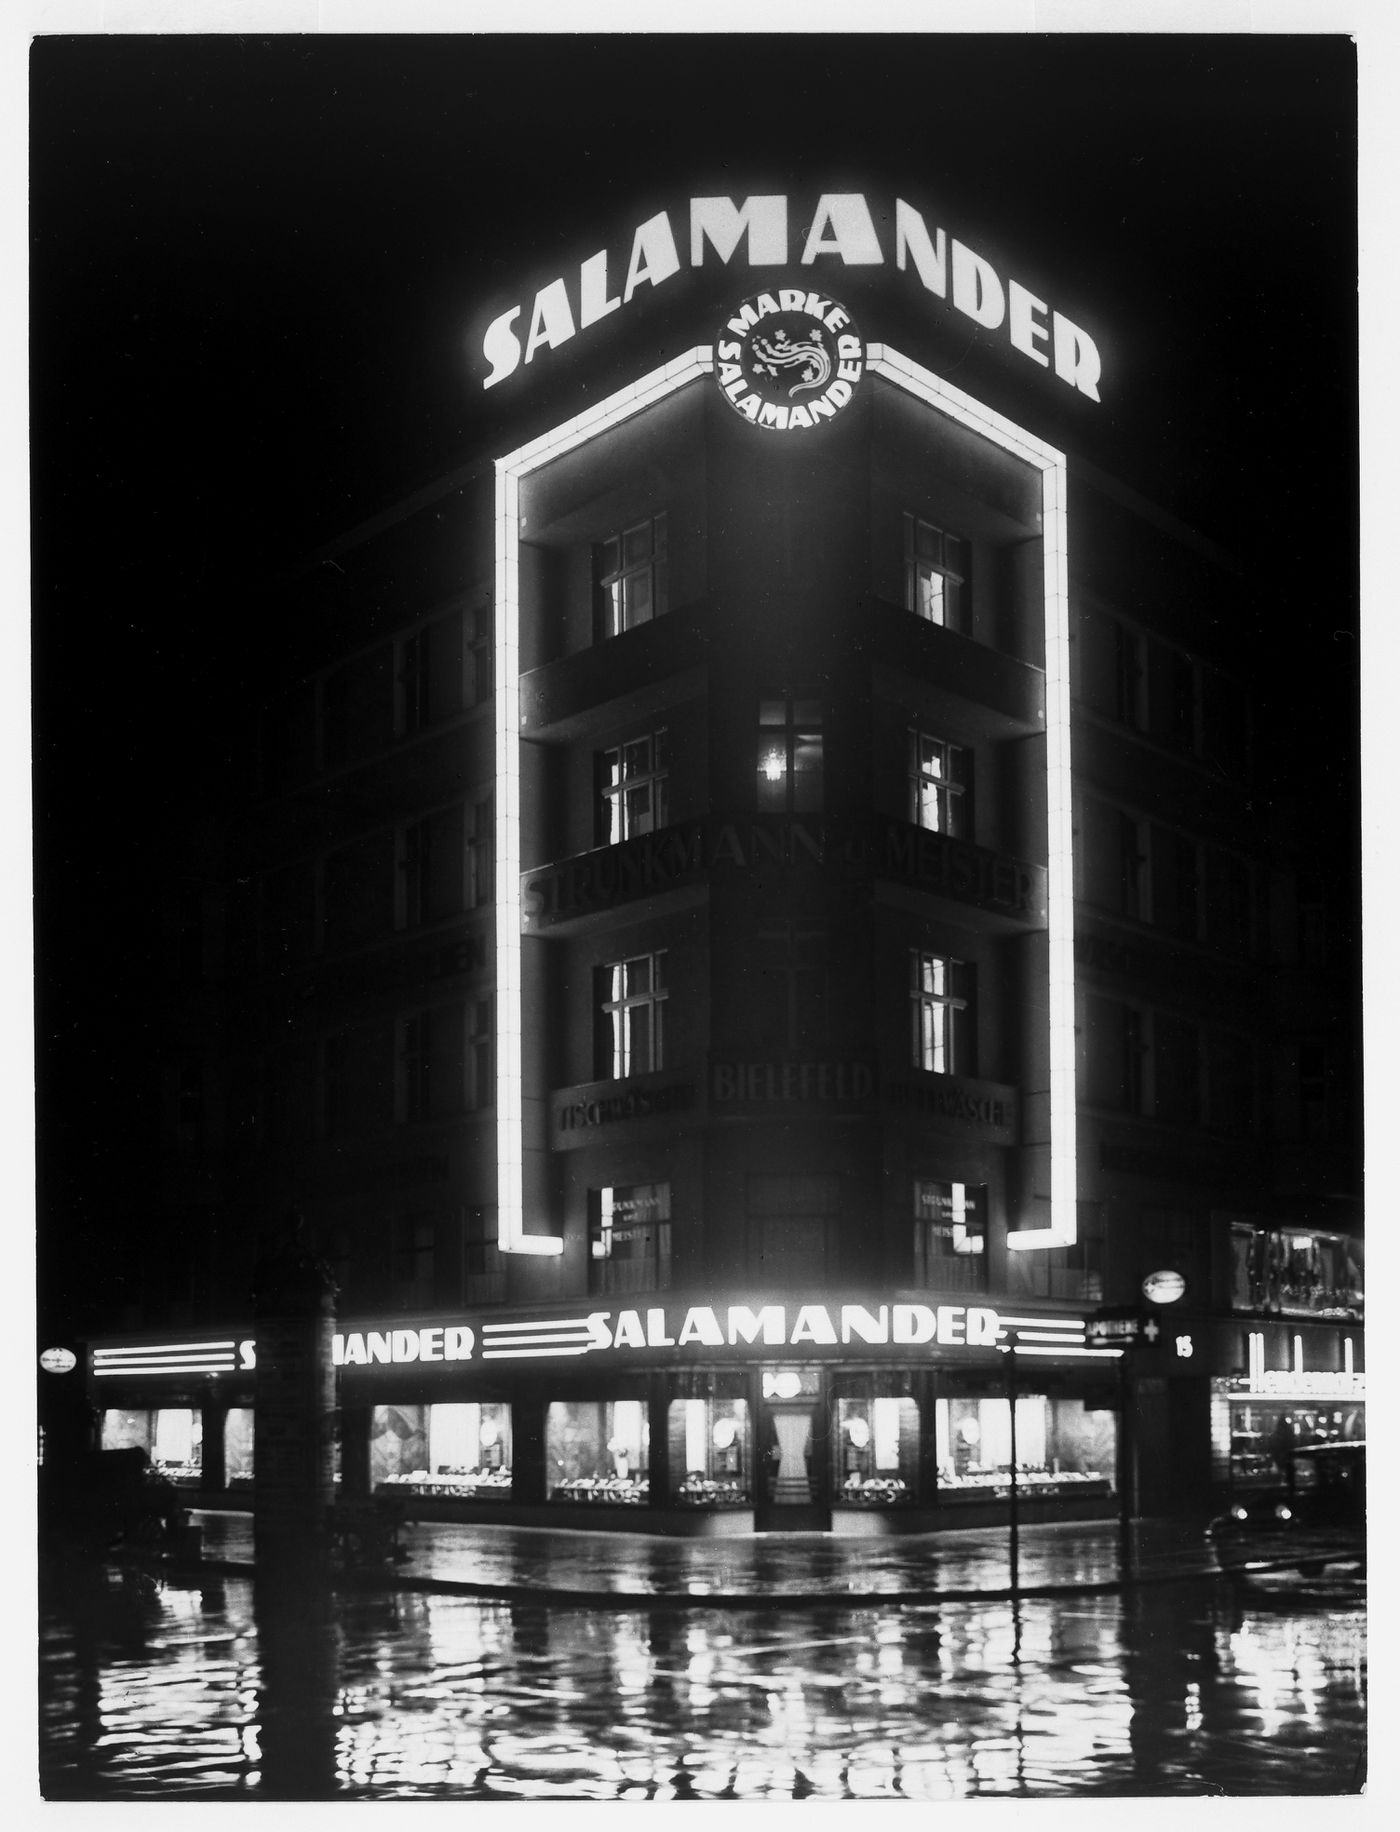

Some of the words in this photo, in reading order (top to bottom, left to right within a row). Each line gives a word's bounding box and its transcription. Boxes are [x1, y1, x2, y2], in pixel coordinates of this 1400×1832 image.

[482, 193, 1102, 404] SALAMANDER
[727, 288, 851, 340] MARKE
[715, 332, 863, 431] SALAMANDER
[523, 821, 827, 918] STRUNKMANN
[886, 824, 1037, 912] MEISTER
[713, 1062, 874, 1102] BIELEFELD
[586, 1304, 1002, 1349] SALAMANDER
